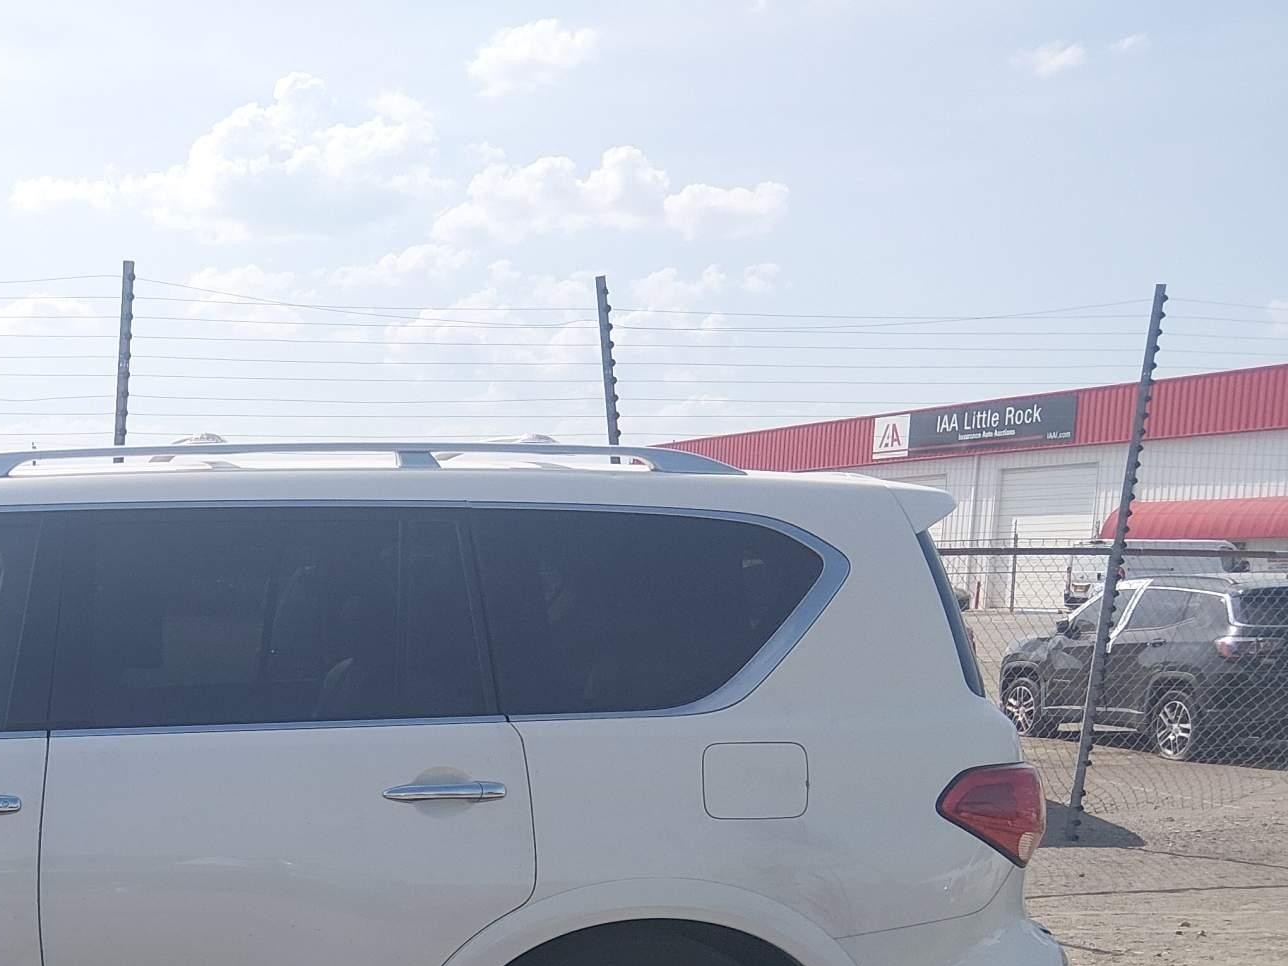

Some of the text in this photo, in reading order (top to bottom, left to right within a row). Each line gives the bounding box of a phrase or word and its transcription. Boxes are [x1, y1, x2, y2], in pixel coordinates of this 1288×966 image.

[936, 404, 1042, 432] IAA Little Rock
